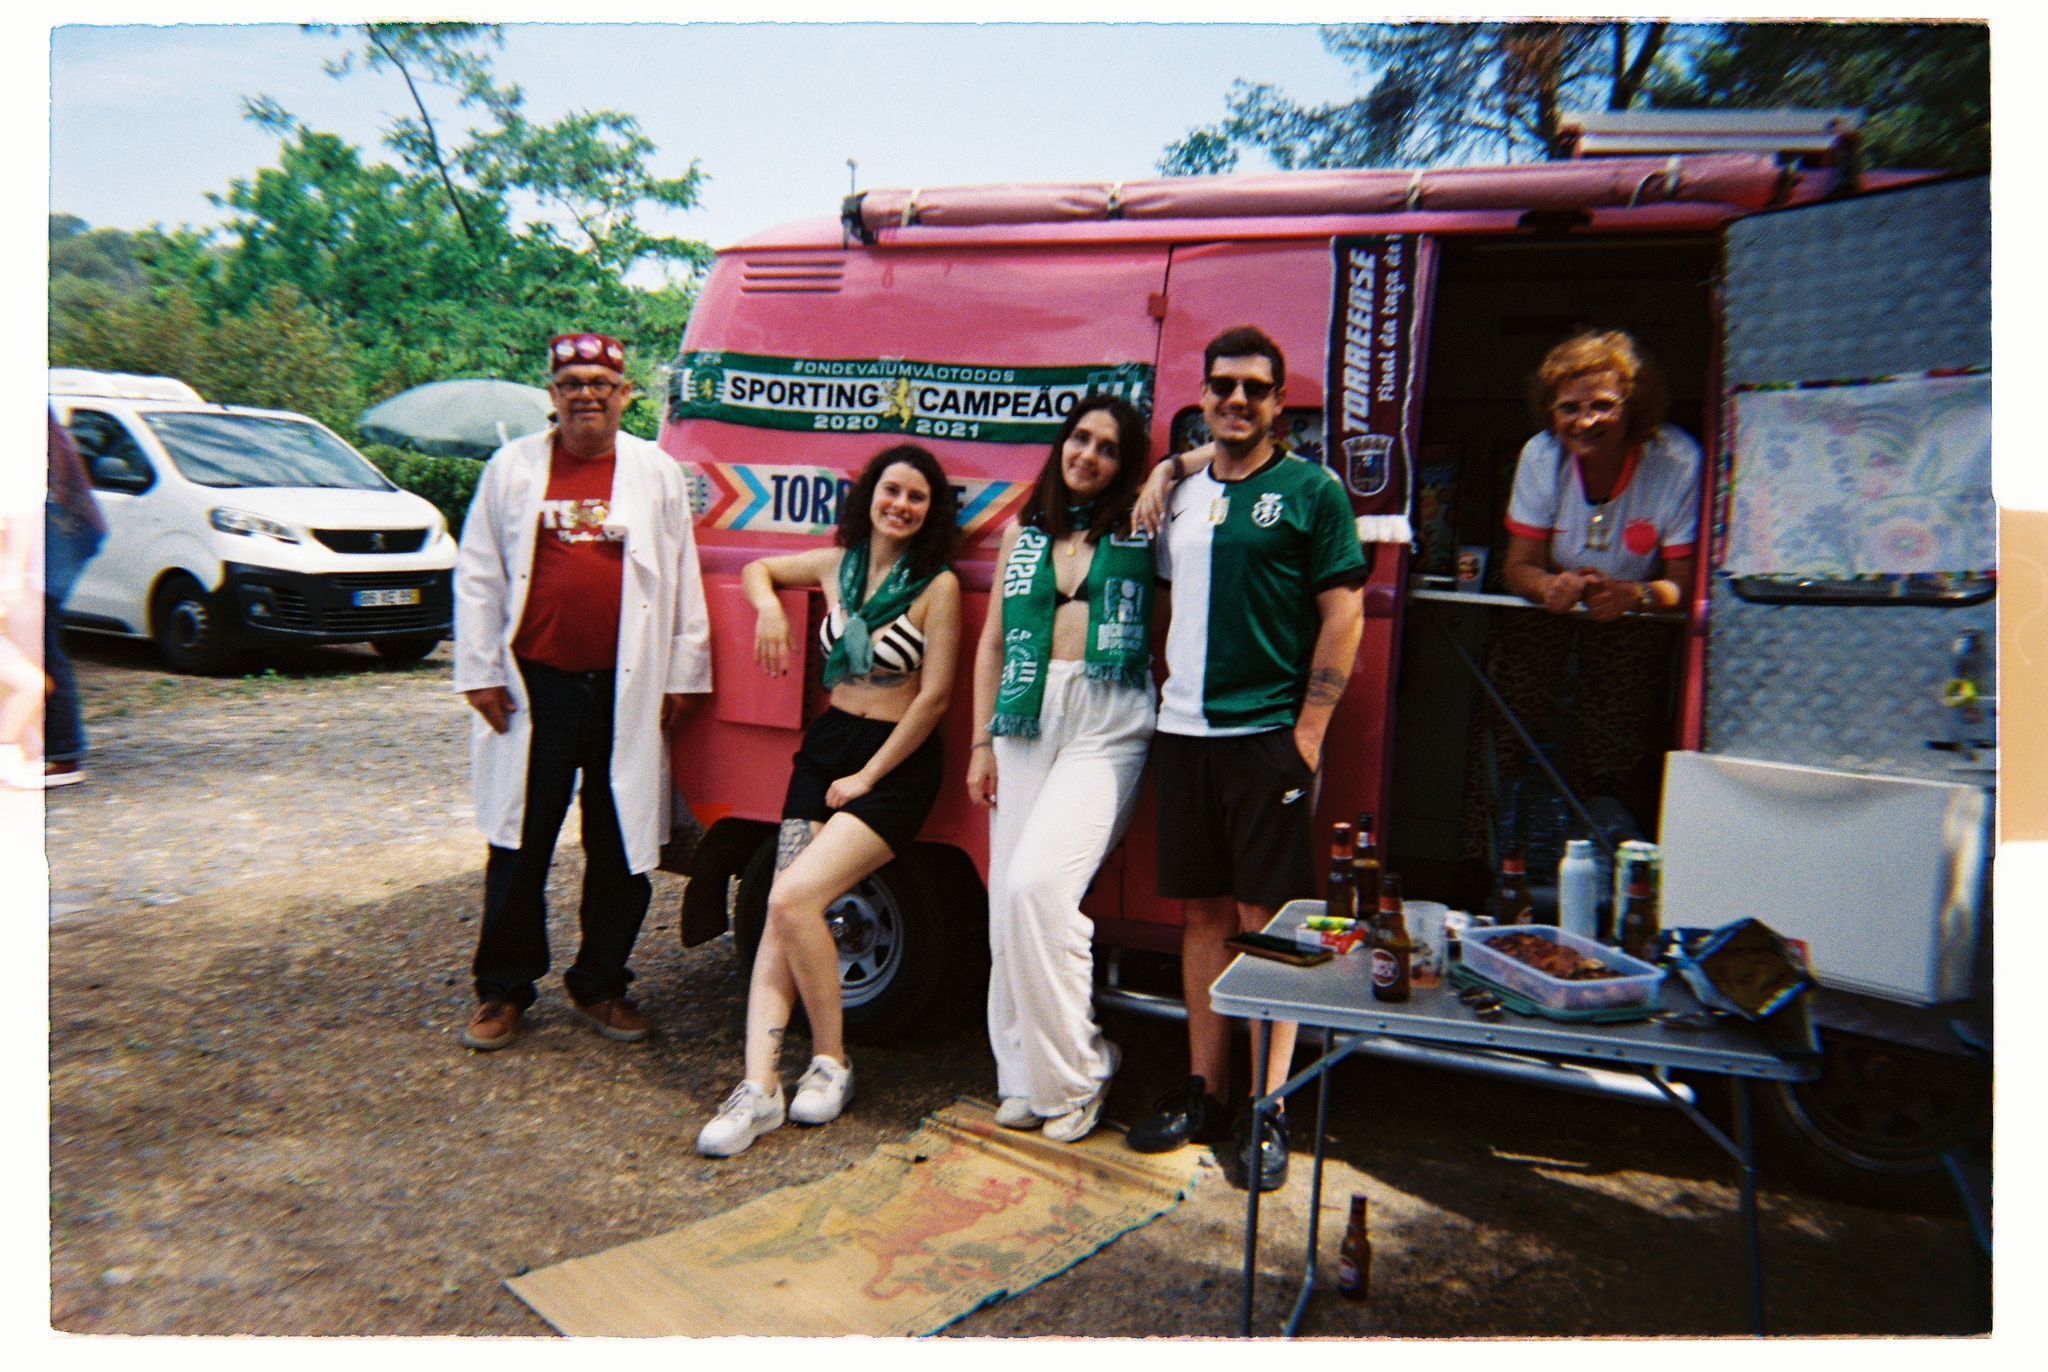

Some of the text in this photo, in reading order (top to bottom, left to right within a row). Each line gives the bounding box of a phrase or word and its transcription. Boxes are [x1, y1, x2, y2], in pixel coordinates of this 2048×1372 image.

[1342, 247, 1377, 434] TORREENSE
[729, 375, 1079, 420] SPORTING CAMPEÃO
[813, 415, 981, 439] 2020 2021
